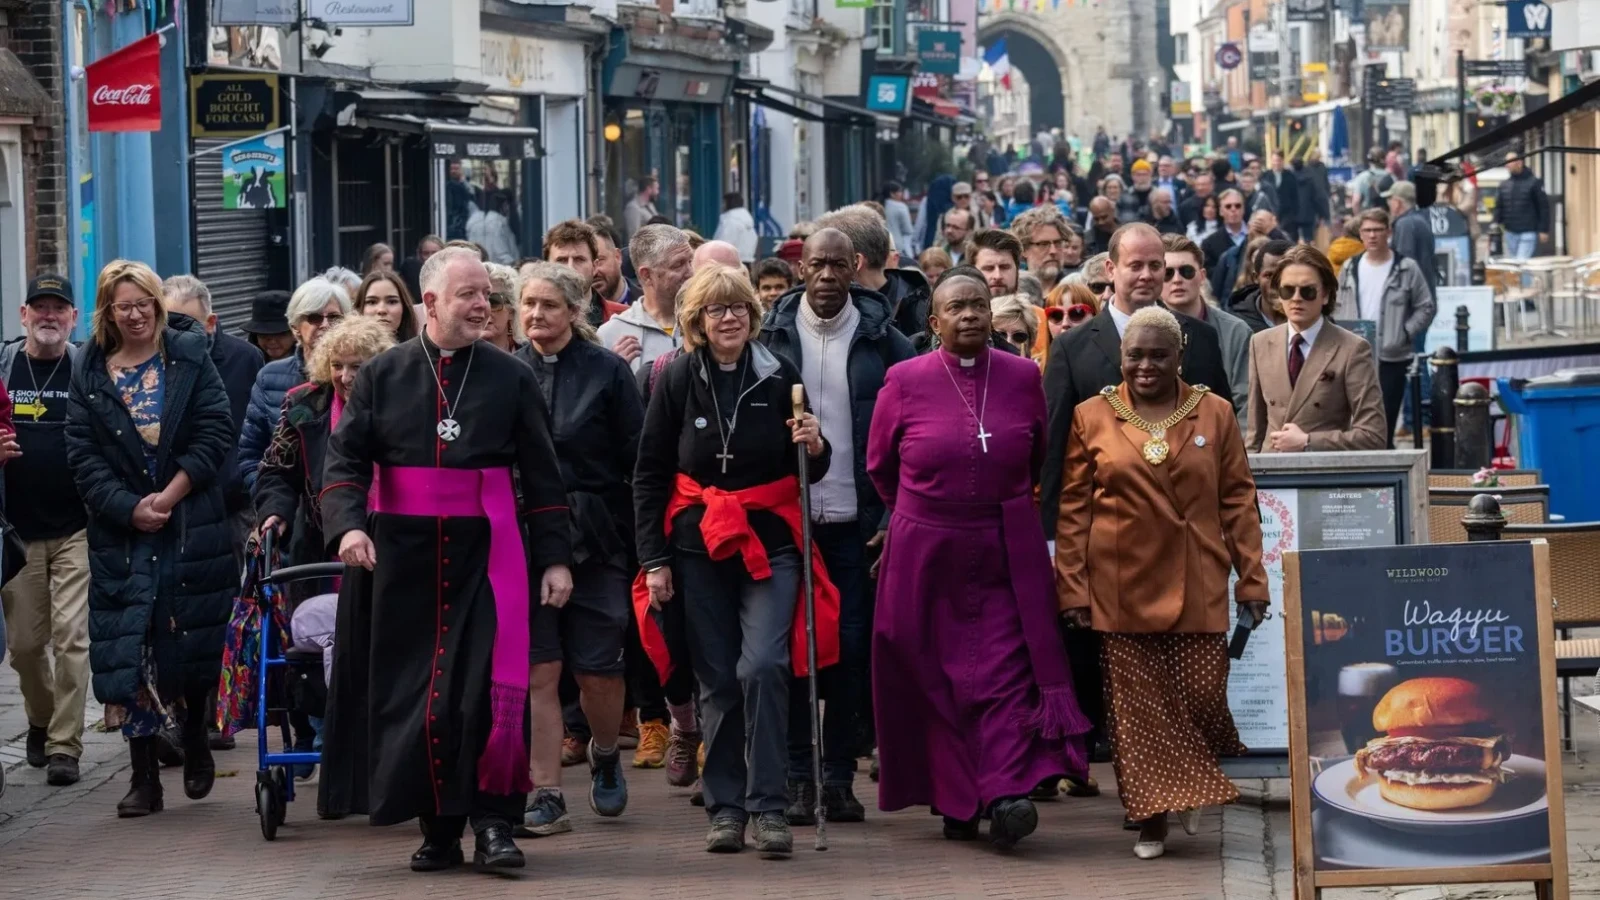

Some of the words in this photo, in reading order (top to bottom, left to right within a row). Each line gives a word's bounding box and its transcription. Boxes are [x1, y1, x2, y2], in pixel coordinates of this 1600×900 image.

[324, 1, 395, 15] Restaurant
[225, 84, 245, 92] ALL
[92, 84, 154, 106] Coca-Cola
[217, 92, 252, 102] GOLD
[209, 102, 260, 113] BOUGHT
[205, 114, 230, 123] FOR
[232, 113, 265, 123] CASH
[42, 390, 54, 398] ME
[1386, 567, 1449, 578] WILDWOOD
[1404, 600, 1510, 642] Wagyu
[1385, 626, 1525, 656] BURGER
